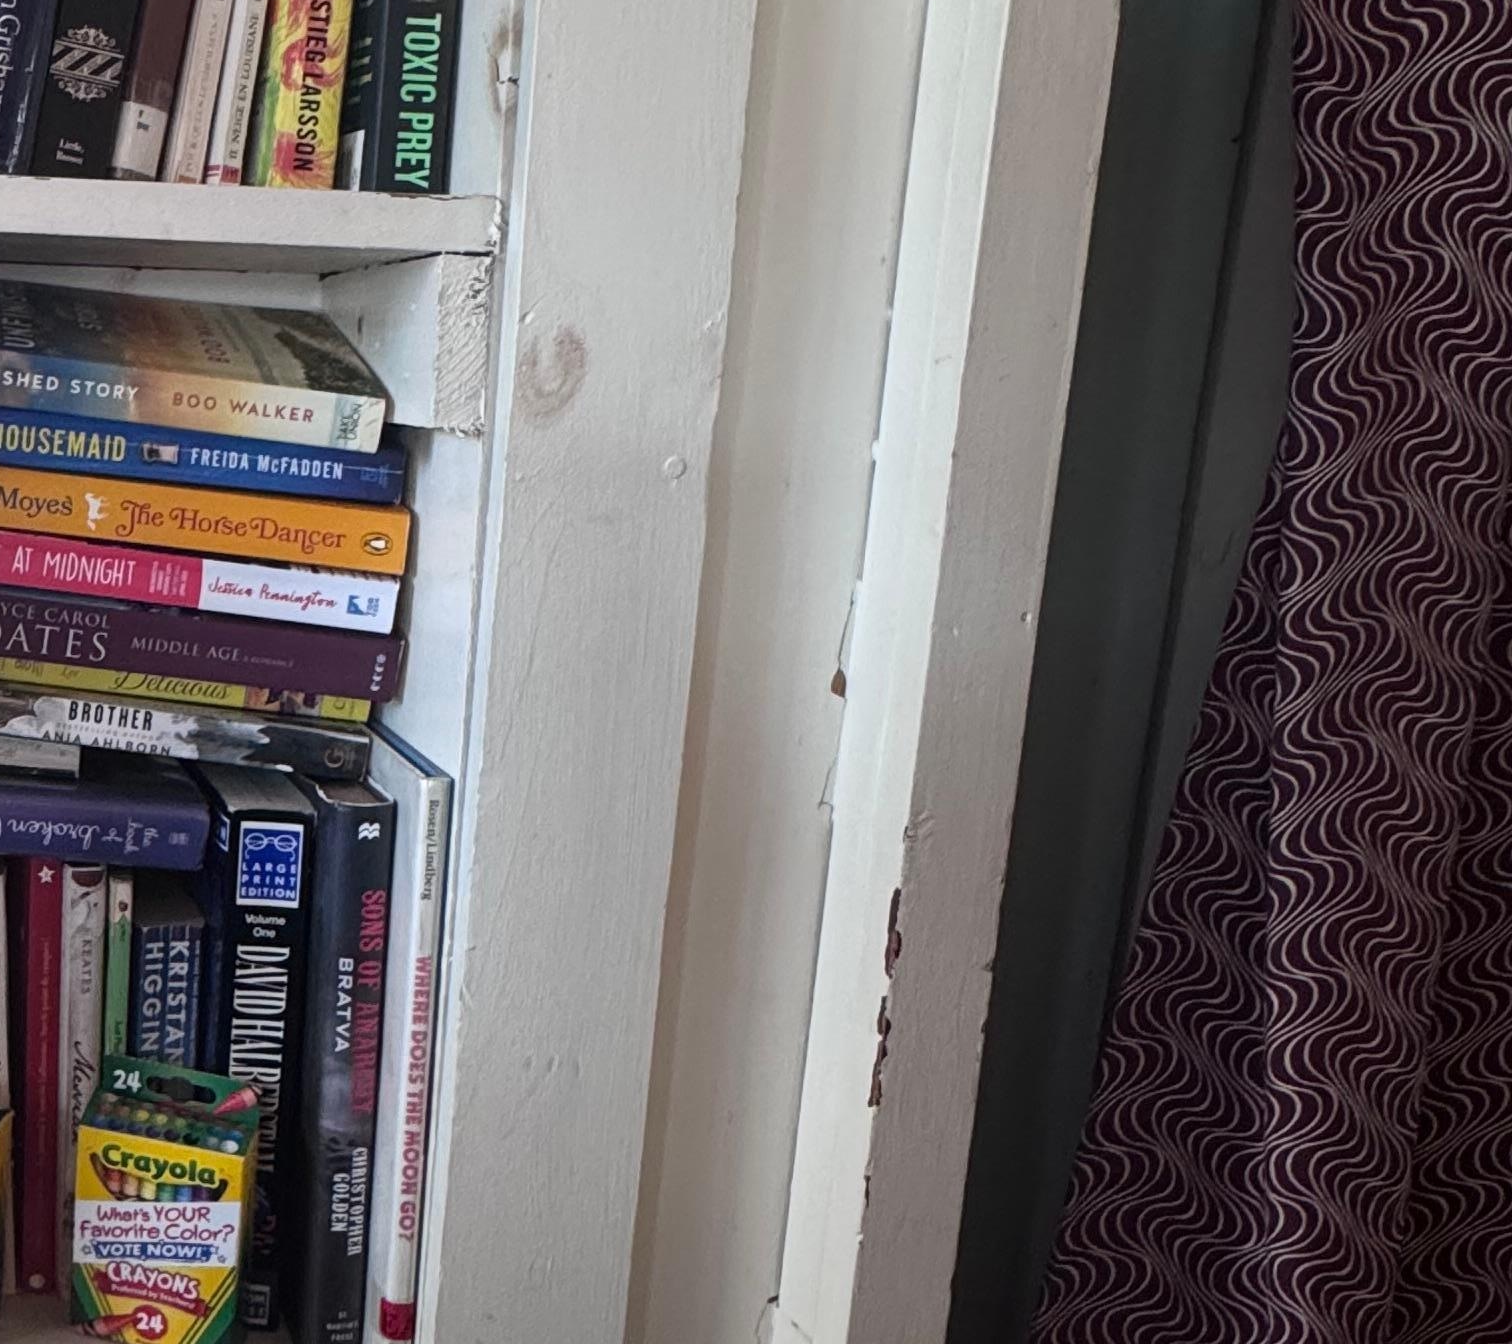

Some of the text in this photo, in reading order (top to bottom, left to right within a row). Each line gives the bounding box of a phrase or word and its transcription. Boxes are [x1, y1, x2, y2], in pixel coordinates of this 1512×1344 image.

[394, 12, 443, 190] TOXIC PREY
[292, 67, 324, 173] LARSSON
[69, 379, 140, 400] STORY
[171, 392, 315, 423] BOO WALKER
[190, 447, 250, 470] FREIDA
[257, 454, 344, 480] McFADDEN
[115, 499, 347, 555] The Horse Dancer
[11, 546, 34, 574] AT
[42, 551, 137, 588] MIDNIGHT
[207, 576, 339, 610] Jessica Pennington
[44, 607, 111, 629] CAROL
[130, 636, 241, 663] MIDDLE AGE
[109, 670, 231, 701] Delicious
[68, 700, 154, 731] BROTHER
[7, 817, 102, 851] broken
[240, 874, 297, 888] PRINT
[241, 861, 298, 875] LARGE
[240, 886, 296, 901] EDITION
[244, 913, 287, 927] Volume
[252, 927, 277, 939] One
[233, 944, 290, 1016] DAVID
[164, 939, 190, 1068] KRISTAN
[334, 956, 354, 1053] BRATVA
[350, 888, 387, 1117] SONS OF ANARCHY
[112, 1069, 142, 1093] 24
[398, 955, 432, 1244] WHERE DOES THE MOON GO?
[101, 1143, 217, 1186] Crayola
[96, 1205, 211, 1222] What's YOUR
[330, 1172, 350, 1233] GOLDEN
[346, 1146, 369, 1258] CHRISTOPHER
[79, 1221, 160, 1240] Favorite
[163, 1223, 235, 1244] Color?
[97, 1242, 204, 1258] VOTE NOW!
[106, 1260, 201, 1300] CRAYONS
[135, 1312, 165, 1334] 24
